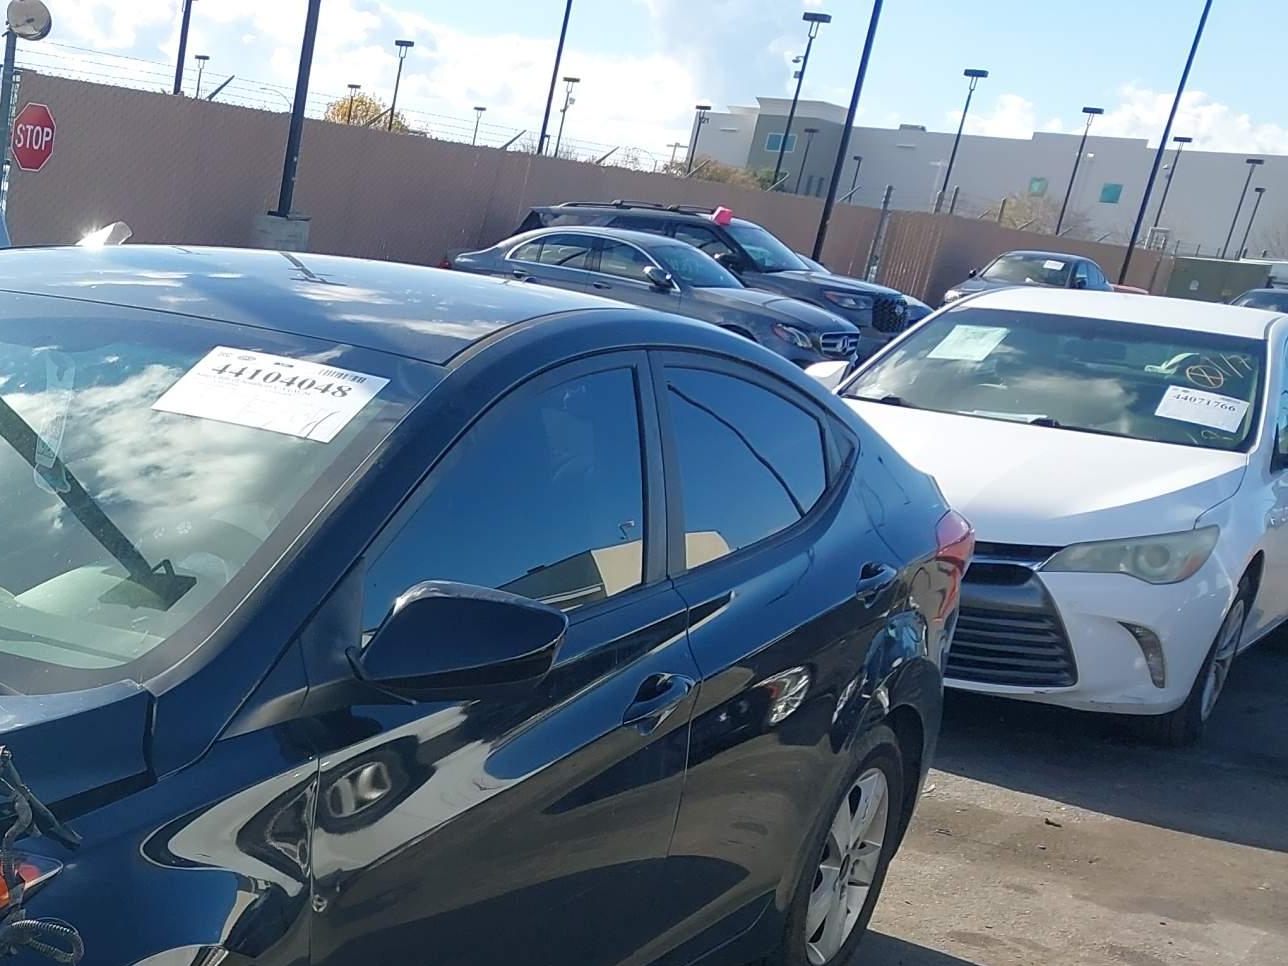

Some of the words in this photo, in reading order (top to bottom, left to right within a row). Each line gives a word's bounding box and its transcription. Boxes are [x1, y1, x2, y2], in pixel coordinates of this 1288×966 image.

[15, 123, 52, 151] STOP
[211, 363, 353, 399] 44104048
[1173, 394, 1237, 413] 44071766
